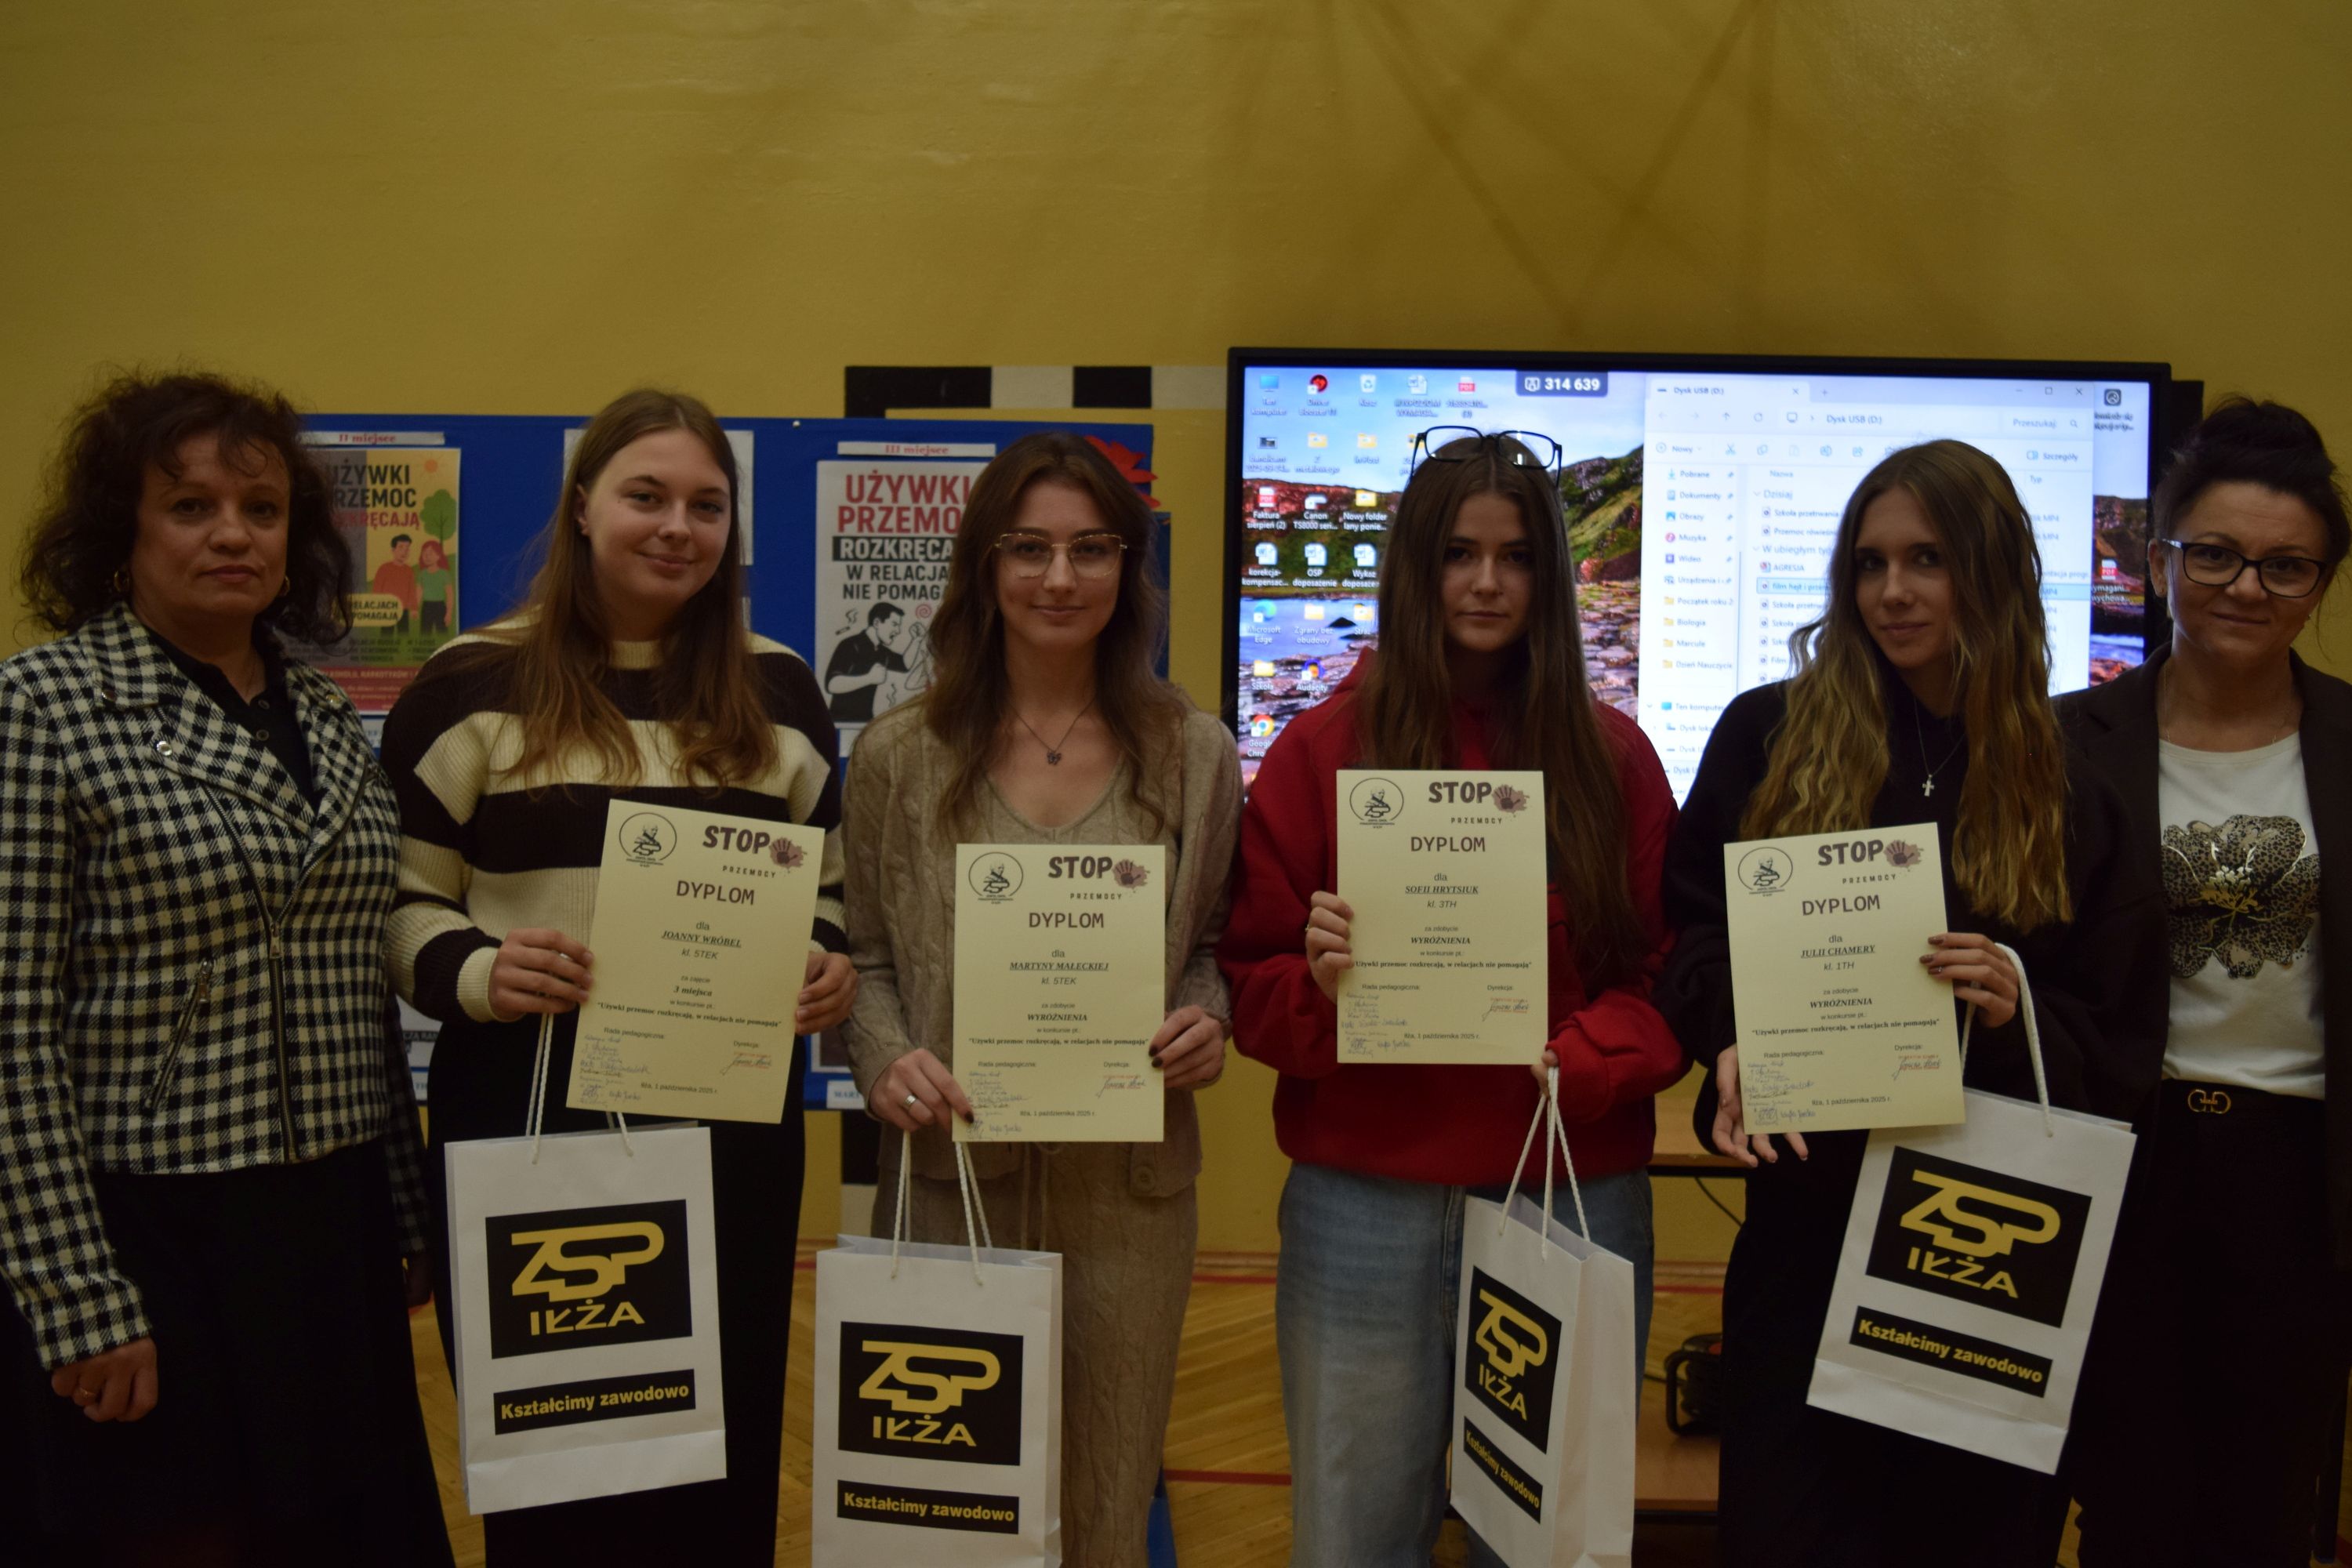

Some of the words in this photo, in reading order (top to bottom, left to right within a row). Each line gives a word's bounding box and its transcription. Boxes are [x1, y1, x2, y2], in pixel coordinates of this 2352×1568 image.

[1544, 377, 1571, 390] 314
[1574, 378, 1600, 391] 639
[1674, 387, 1692, 396] Dysk
[1694, 387, 1709, 395] USB
[1827, 414, 1846, 424] Dysk
[1848, 415, 1865, 424] USB
[885, 445, 900, 454] III
[904, 445, 949, 456] miejsce
[845, 470, 970, 505] UŻYWKI
[333, 488, 416, 508] RZEMOC
[837, 506, 963, 535] PRZEMO
[1343, 512, 1364, 521] Nowy
[1365, 512, 1388, 521] folder
[1276, 521, 1287, 530] (2)
[839, 538, 954, 563] ROZKRĘCA
[846, 564, 863, 581] W
[870, 565, 949, 582] RELACJA
[1307, 568, 1323, 577] OSP
[843, 584, 871, 600] NIE
[877, 584, 941, 601] POMAG
[1254, 636, 1272, 644] Edge
[1296, 684, 1328, 692] Audacity
[1248, 739, 1272, 748] Googl
[1247, 749, 1264, 757] Chro
[1428, 781, 1493, 804] STOP
[702, 825, 770, 854] STOP
[1410, 836, 1486, 853] DYPLOM
[1818, 839, 1883, 866] STOP
[722, 865, 776, 878] PRZEMOCY
[1048, 856, 1112, 879] STOP
[1434, 873, 1447, 881] dla
[1842, 873, 1896, 884] PRZEMOCY
[677, 880, 755, 905] DYPLOM
[1405, 885, 1430, 895] SOFII
[1802, 895, 1881, 916] DYPLOM
[696, 921, 710, 931] dla
[1029, 913, 1105, 929] DYPLOM
[662, 930, 700, 942] JOANNY
[1828, 935, 1842, 944] dla
[1051, 949, 1065, 958] dla
[1801, 948, 1826, 959] JULII
[1010, 962, 1054, 971] MARTYNY
[1899, 1168, 2062, 1258] ZSP
[510, 1220, 665, 1303] ZSP
[1907, 1245, 2020, 1301] IŁŻA
[529, 1298, 646, 1337] IŁŻA
[1475, 1287, 1548, 1377] ZSP
[1857, 1319, 1951, 1360] Kształcimy
[1952, 1347, 2043, 1384] zawodowo
[858, 1339, 1001, 1414] ZSP
[1479, 1363, 1528, 1421] IŁŻA
[500, 1393, 595, 1421] Kształcimy
[600, 1384, 691, 1407] zawodowo
[872, 1414, 978, 1447] IŁŻA
[1466, 1429, 1499, 1476] Kształcimy
[1501, 1466, 1540, 1510] zawodowo
[844, 1492, 927, 1517] Kształcimy
[931, 1503, 1015, 1522] zawodowo
